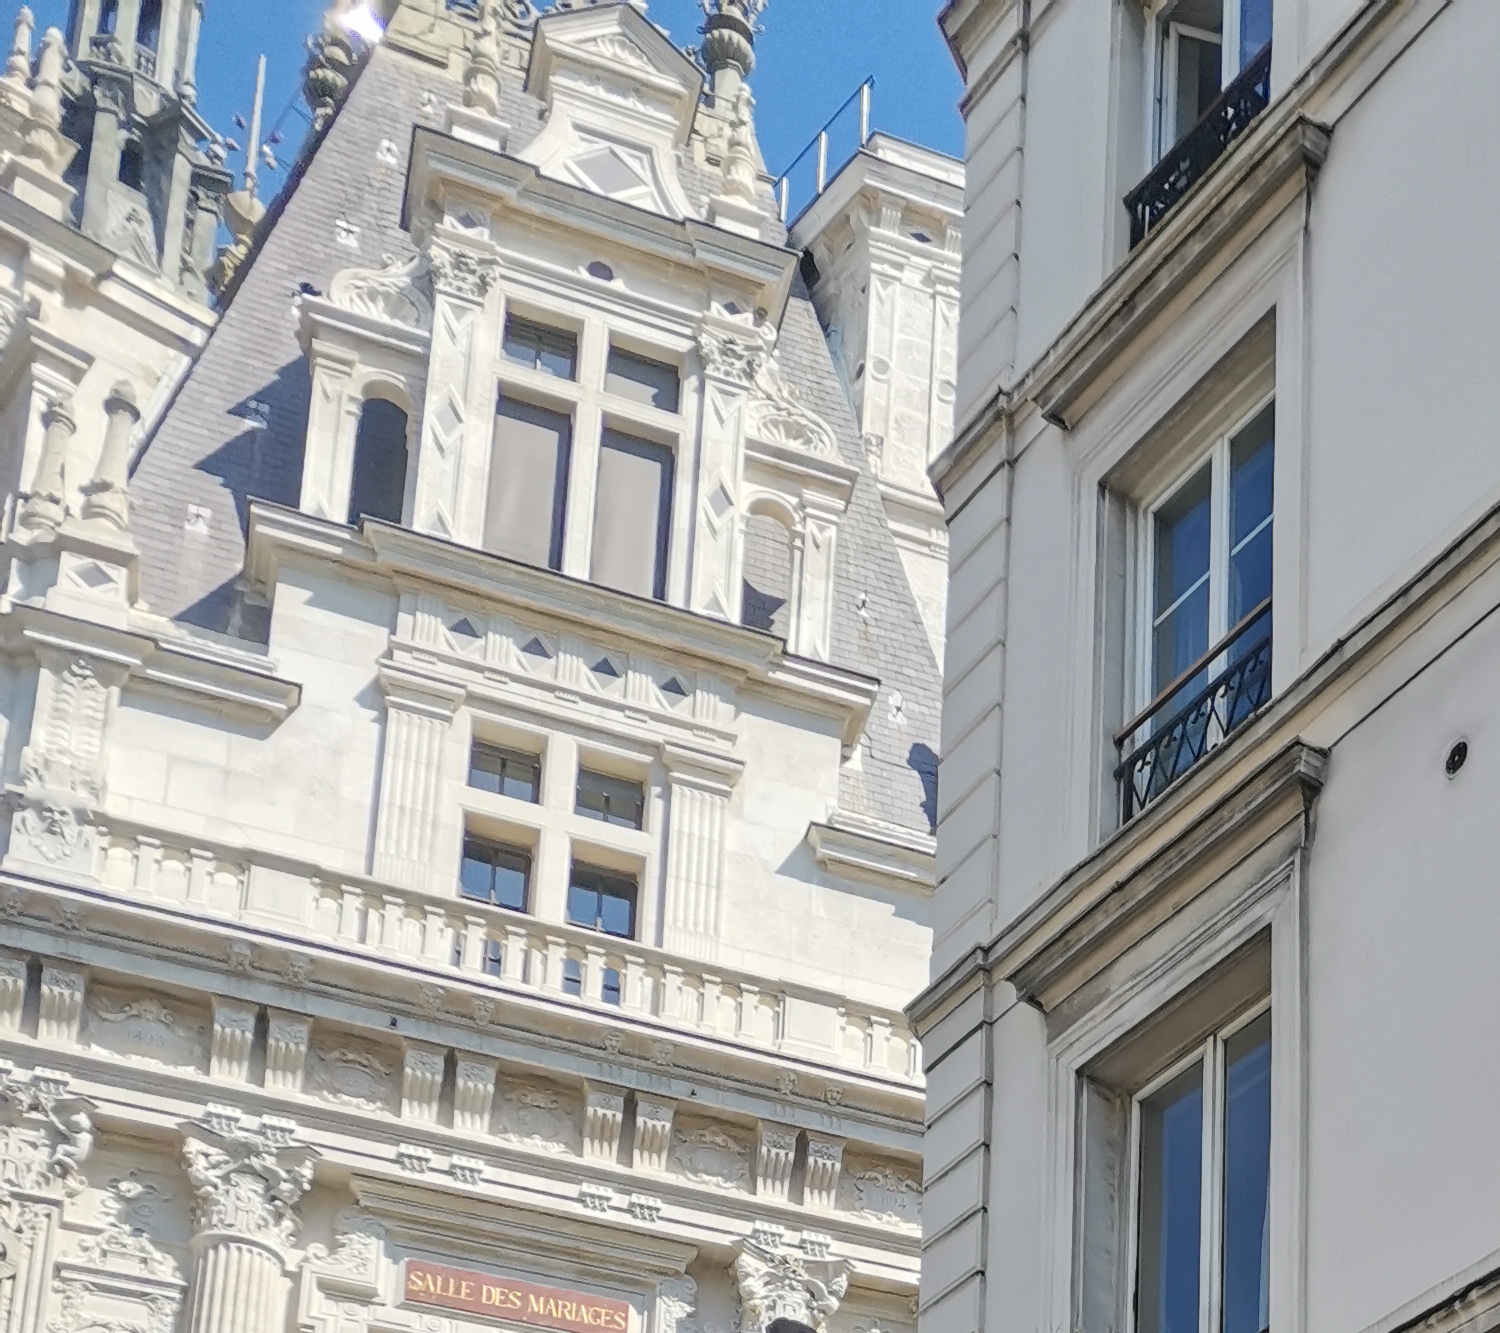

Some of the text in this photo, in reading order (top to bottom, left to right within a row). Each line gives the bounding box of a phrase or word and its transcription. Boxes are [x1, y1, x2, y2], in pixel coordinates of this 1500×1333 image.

[408, 1271, 626, 1330] SALLE DES MARIAGES
